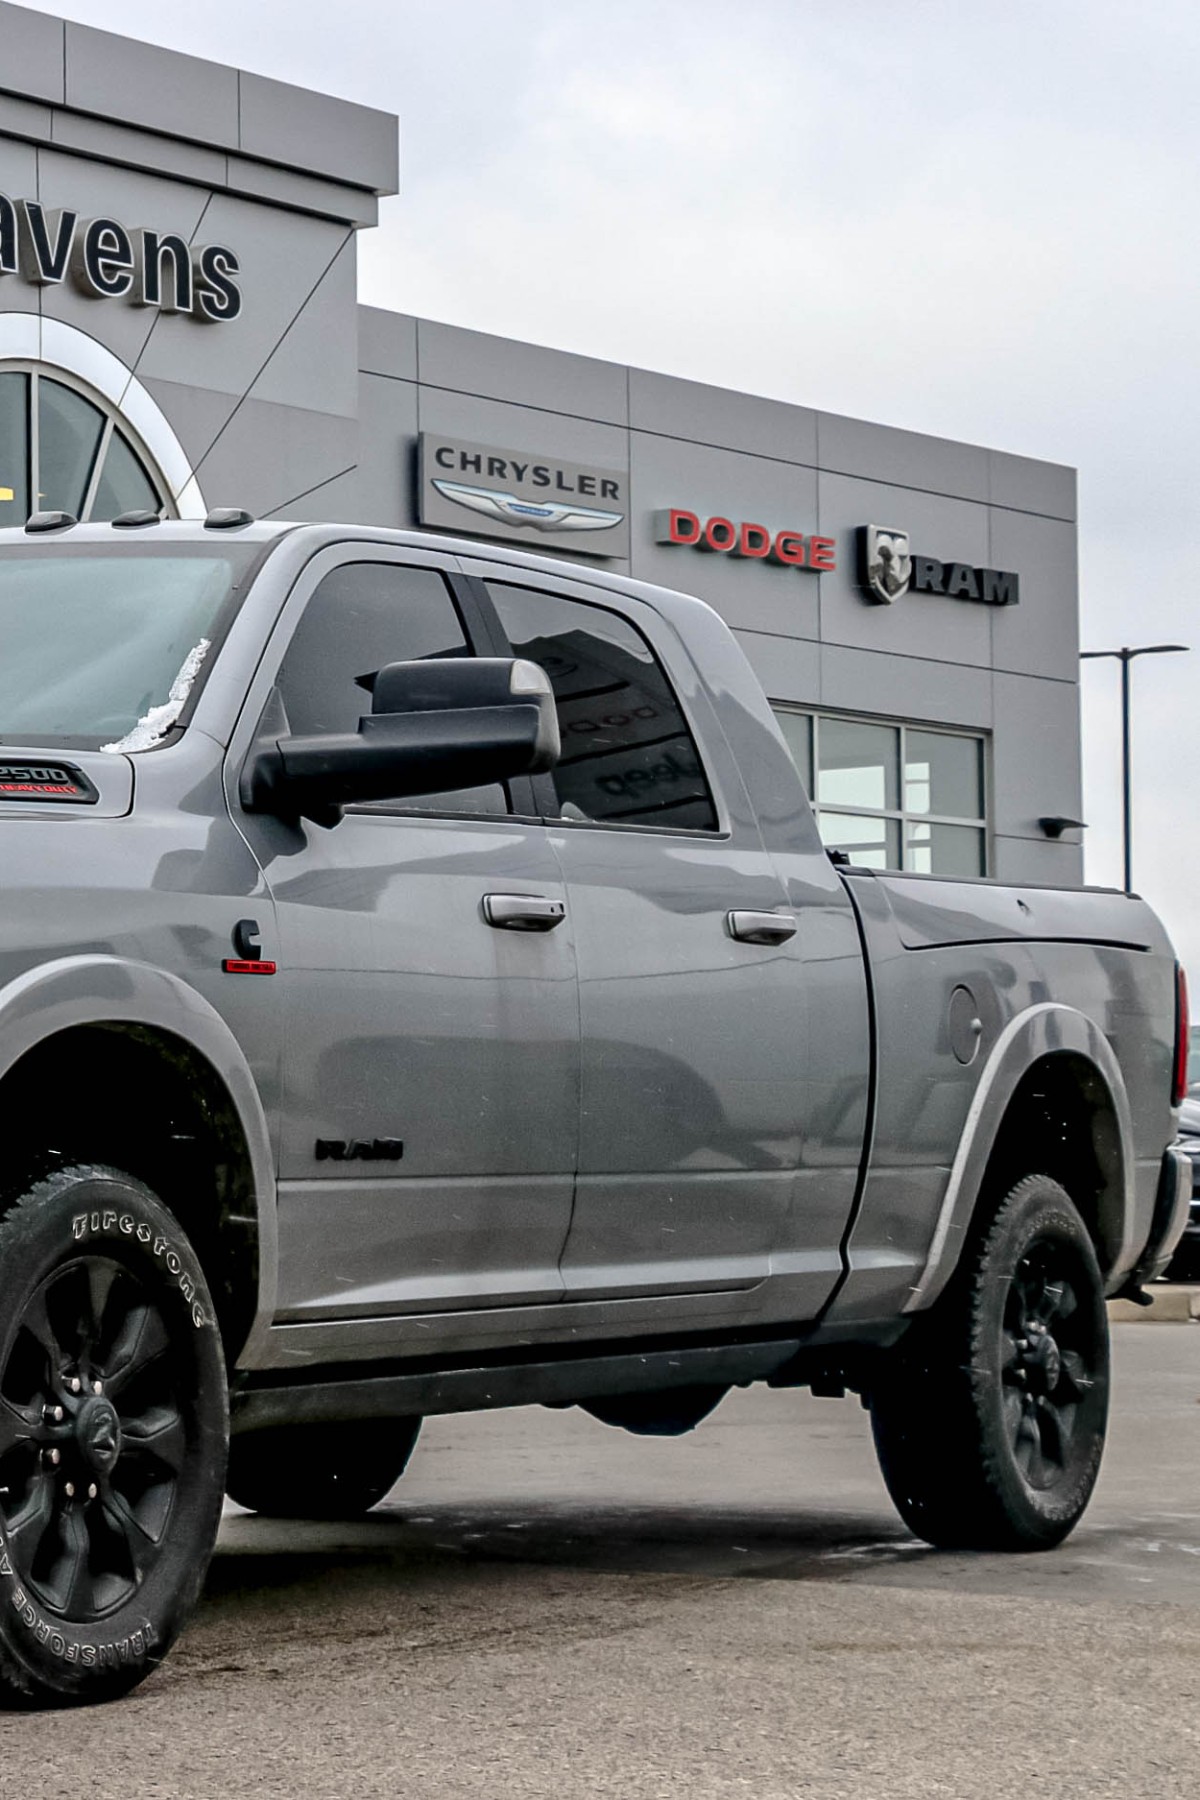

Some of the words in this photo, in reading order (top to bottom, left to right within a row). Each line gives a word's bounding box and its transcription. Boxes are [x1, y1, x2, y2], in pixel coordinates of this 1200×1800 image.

[435, 447, 620, 500] CHRYSLER
[660, 508, 837, 571] DODGE
[912, 556, 1020, 606] RAM
[44, 785, 78, 794] DUTY
[315, 1137, 404, 1160] RAM
[72, 1210, 205, 1328] Firestone
[12, 1587, 160, 1667] TRANSFORCE
